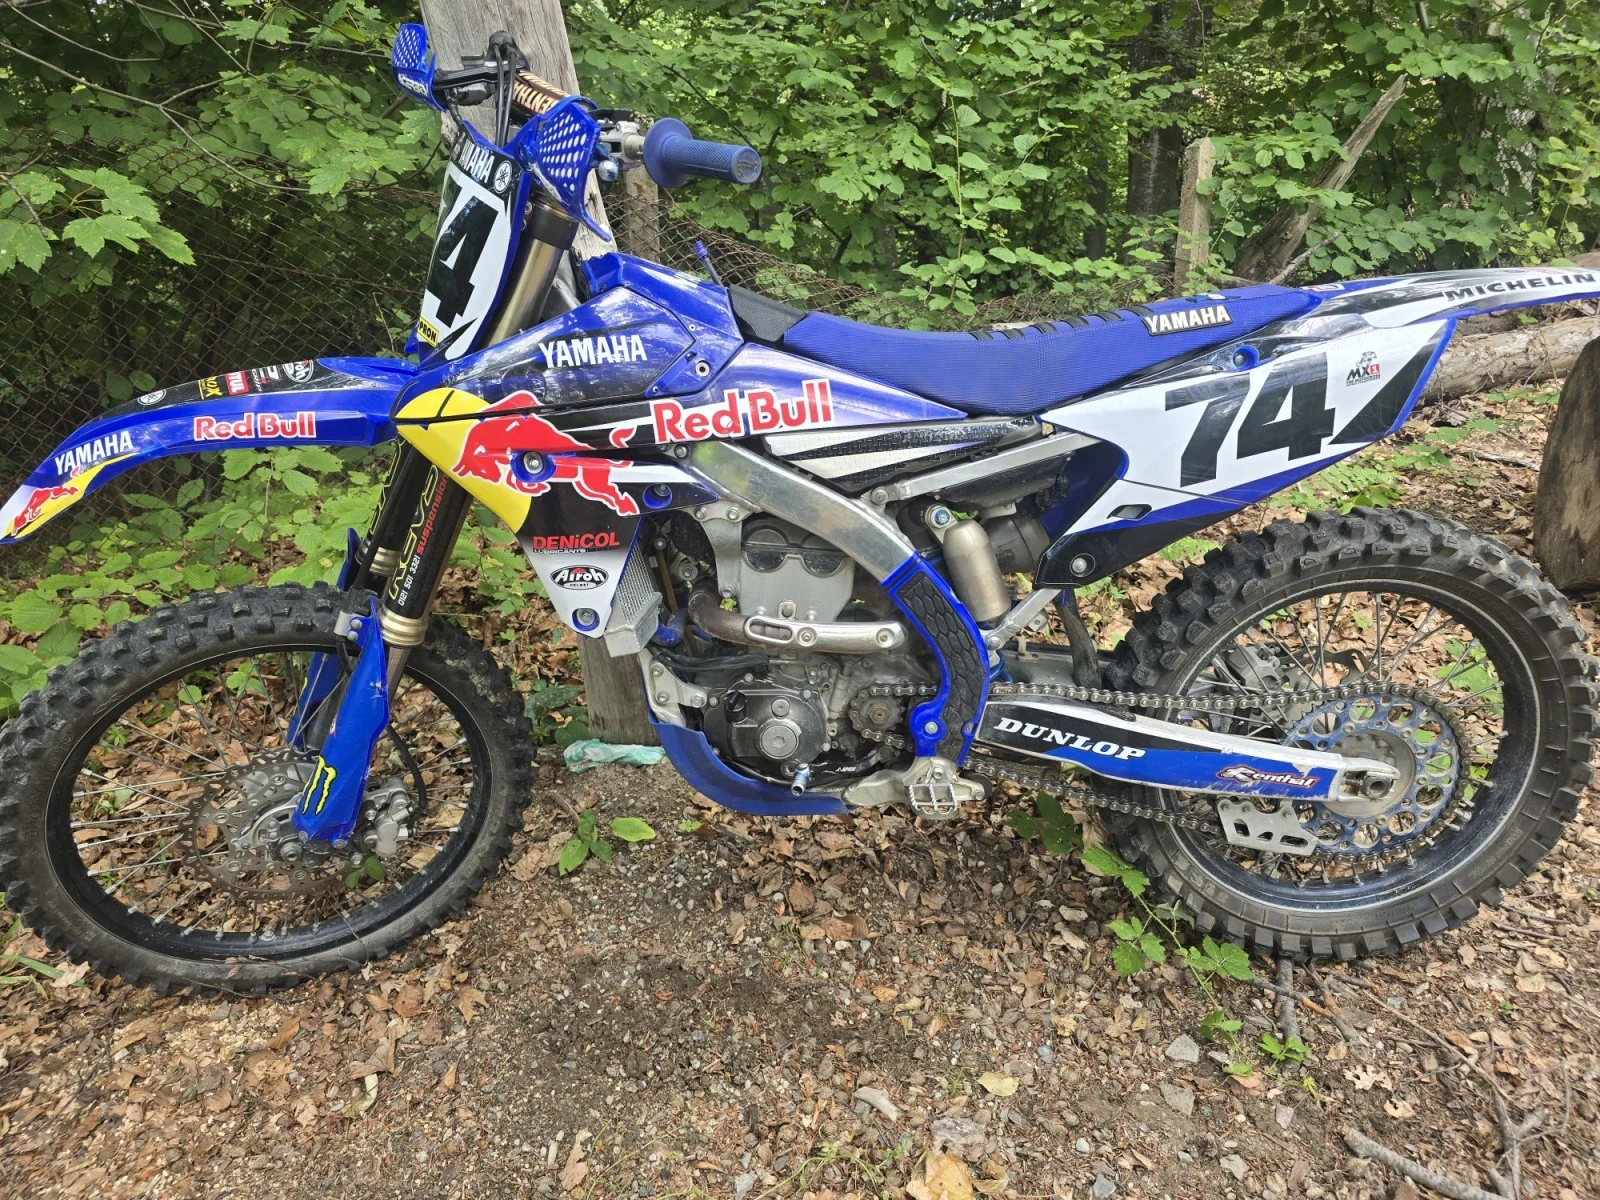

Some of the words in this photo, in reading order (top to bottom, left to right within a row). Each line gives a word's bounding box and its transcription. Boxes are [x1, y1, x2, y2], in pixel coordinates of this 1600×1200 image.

[512, 80, 557, 115] ENTHA
[1447, 273, 1597, 301] MICHELIN
[419, 320, 437, 343] PRON
[1144, 304, 1231, 333] YAMAHA
[538, 334, 648, 369] YAMAHA
[228, 371, 245, 393] TUL
[195, 413, 254, 440] Red
[258, 412, 316, 438] Bull
[651, 391, 744, 444] Red
[746, 380, 834, 432] Bull
[1165, 352, 1336, 487] 74
[54, 430, 134, 476] YAMAHA
[397, 591, 408, 607] 0121
[404, 575, 414, 590] 501
[409, 554, 421, 575] 3321
[416, 473, 449, 556] suspension
[554, 567, 605, 582] Airoh
[994, 717, 1147, 760] DUNLOP
[1221, 767, 1318, 787] Renthal
